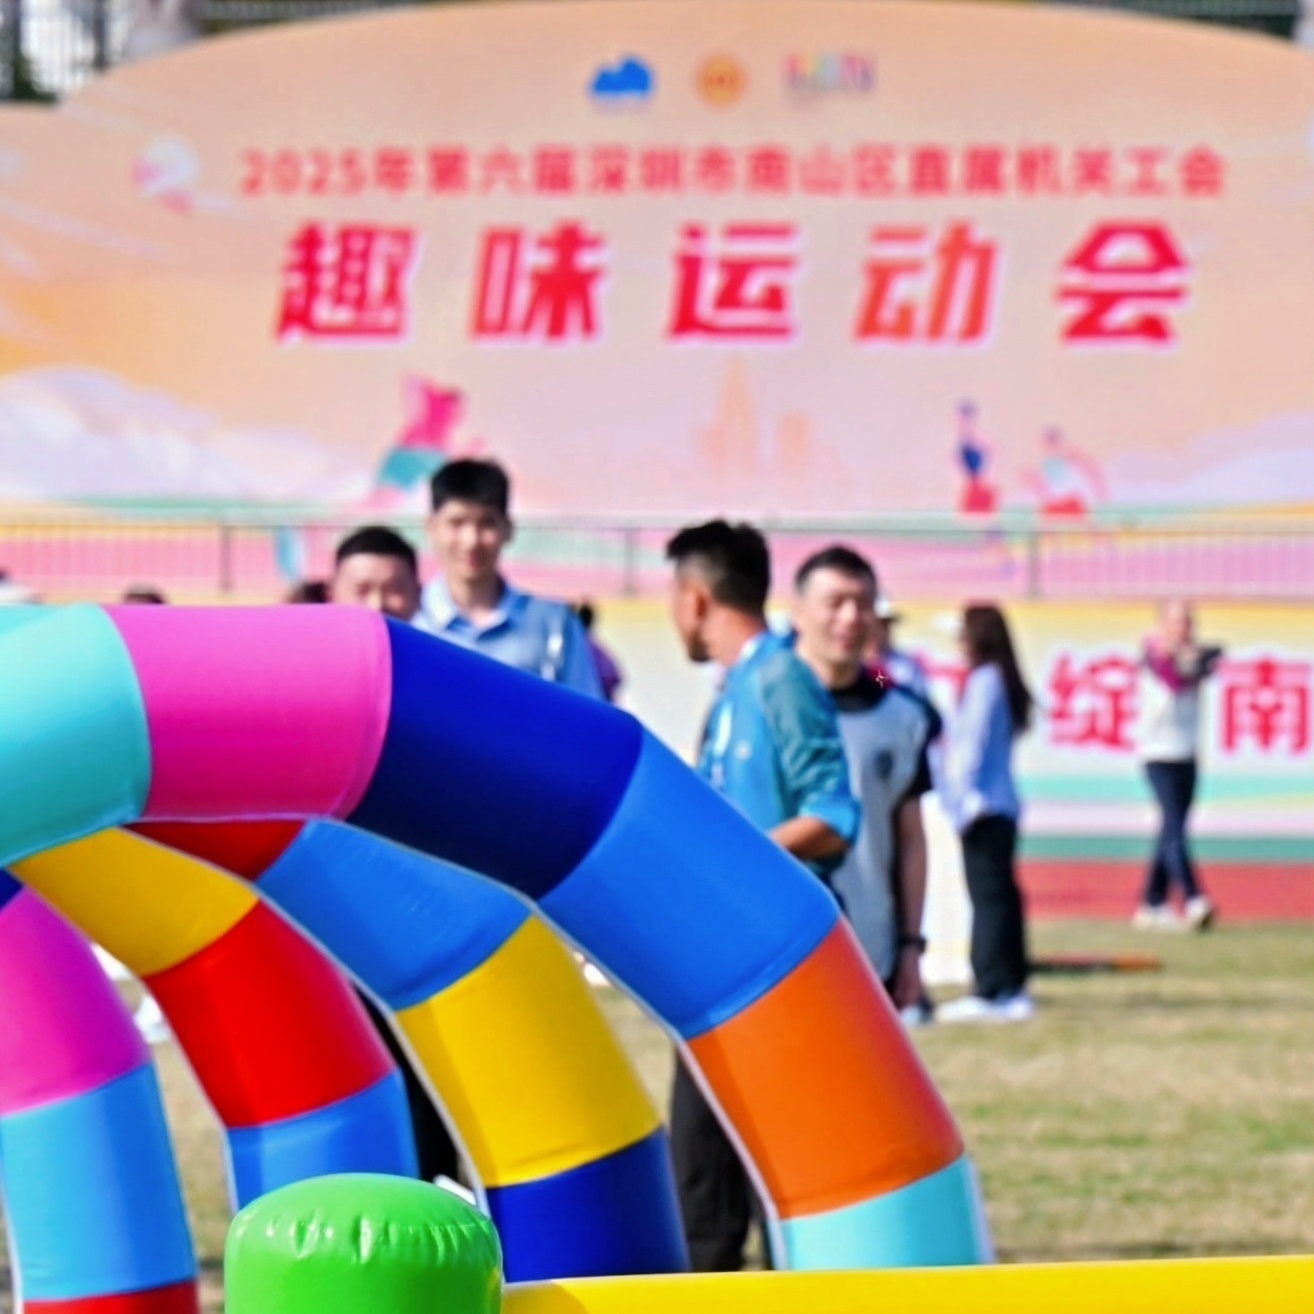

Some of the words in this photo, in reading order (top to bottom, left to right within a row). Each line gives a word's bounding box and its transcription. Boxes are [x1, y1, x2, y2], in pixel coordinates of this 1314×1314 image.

[242, 146, 1224, 196] 2025年第六届深圳市南山区直属机关工会
[277, 219, 1187, 340] 趣味运动会
